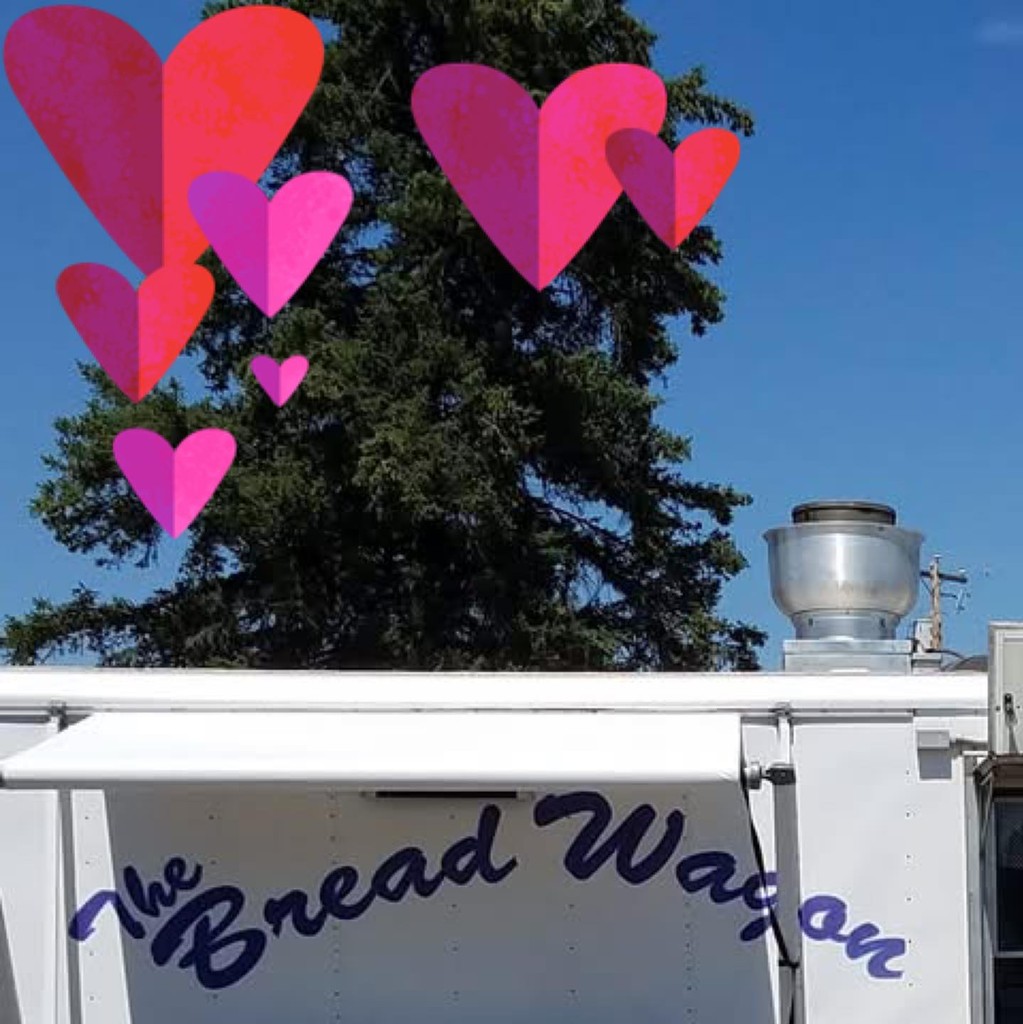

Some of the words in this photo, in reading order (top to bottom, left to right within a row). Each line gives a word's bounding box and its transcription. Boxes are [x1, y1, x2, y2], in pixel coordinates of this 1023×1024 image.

[70, 854, 205, 942] The
[151, 805, 519, 990] Bread
[532, 793, 906, 980] Wagon
